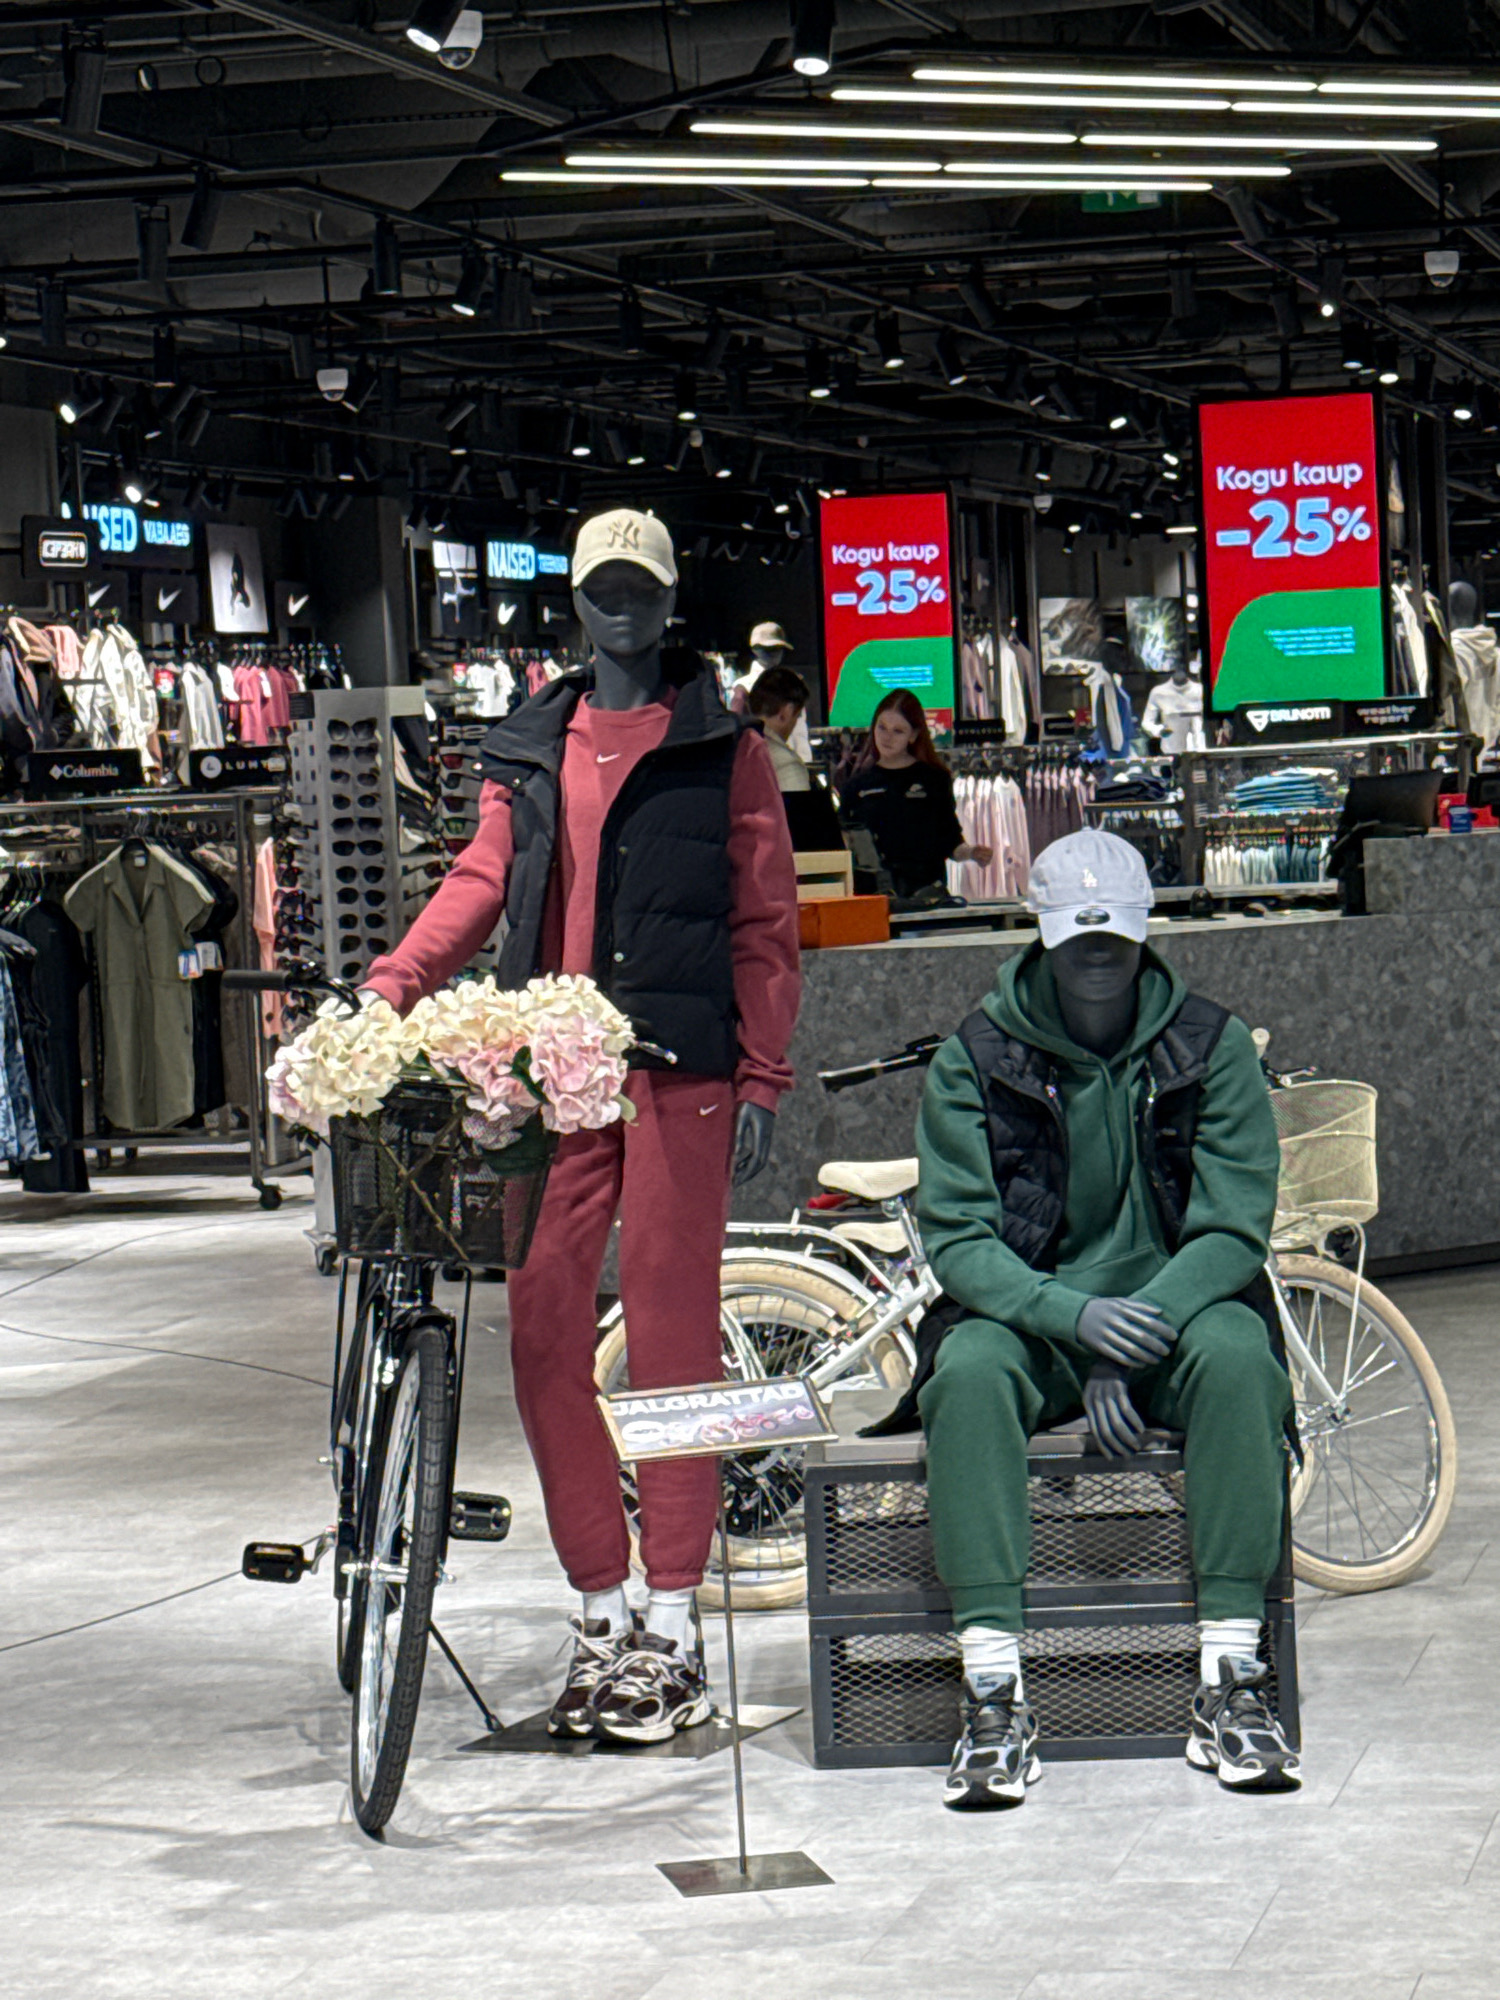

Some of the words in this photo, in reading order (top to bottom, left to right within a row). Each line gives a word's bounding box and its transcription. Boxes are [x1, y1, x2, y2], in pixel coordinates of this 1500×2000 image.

[1216, 465, 1287, 495] Kogu
[1293, 461, 1363, 490] kaup
[1216, 497, 1371, 559] -25%
[487, 541, 536, 580] NAISED
[831, 544, 884, 568] Kogu
[887, 541, 940, 565] kaup
[831, 569, 946, 615] -25%
[62, 763, 120, 779] Columbia
[613, 1385, 804, 1416] JALGRATTAD
